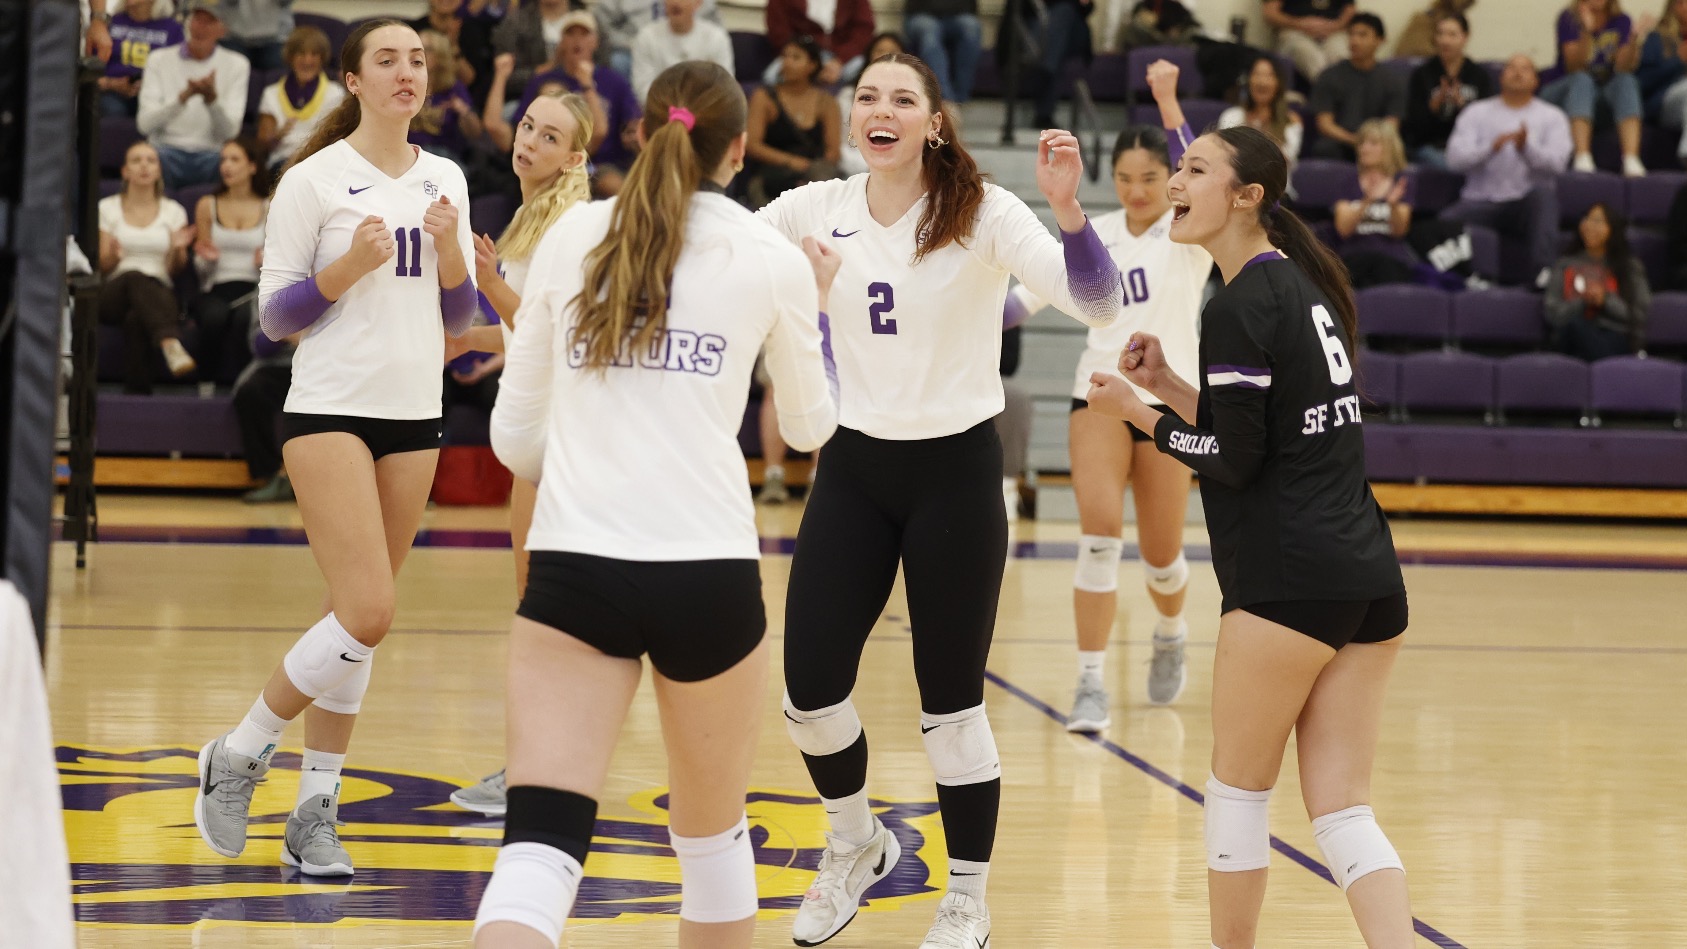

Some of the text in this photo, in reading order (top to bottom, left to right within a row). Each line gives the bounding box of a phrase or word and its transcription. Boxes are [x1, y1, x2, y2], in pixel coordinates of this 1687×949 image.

[423, 180, 439, 199] SF
[395, 226, 422, 278] 11
[867, 281, 898, 335] 2
[566, 326, 727, 377] GTORS
[1311, 303, 1353, 386] 6
[1301, 403, 1328, 435] SF
